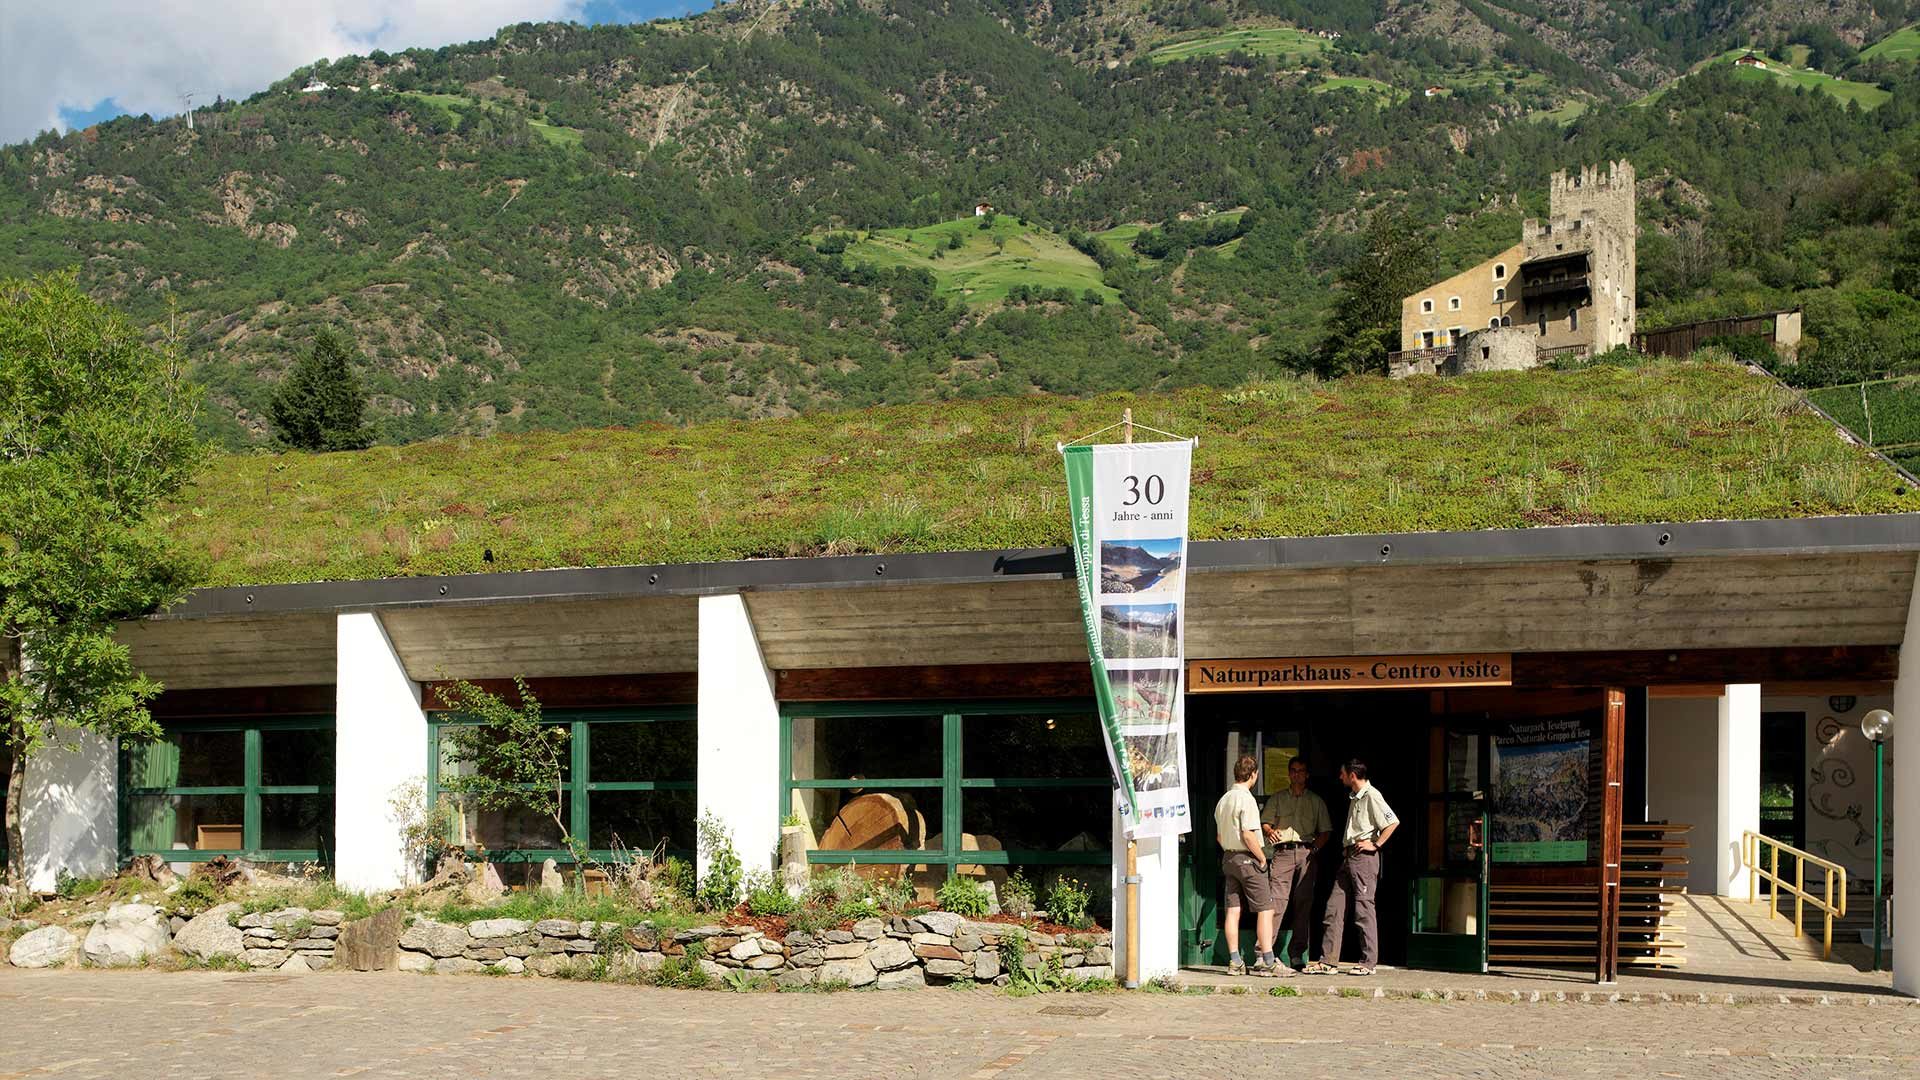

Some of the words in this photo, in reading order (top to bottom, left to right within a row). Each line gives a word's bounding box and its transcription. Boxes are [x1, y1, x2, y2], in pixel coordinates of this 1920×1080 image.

[1122, 474, 1165, 506] 30
[1079, 496, 1090, 528] Tessa
[1112, 511, 1140, 522] Jahre
[1150, 509, 1173, 520] anni
[1200, 665, 1351, 687] Naturparkhaus
[1371, 661, 1441, 680] Centro
[1448, 661, 1501, 679] visite
